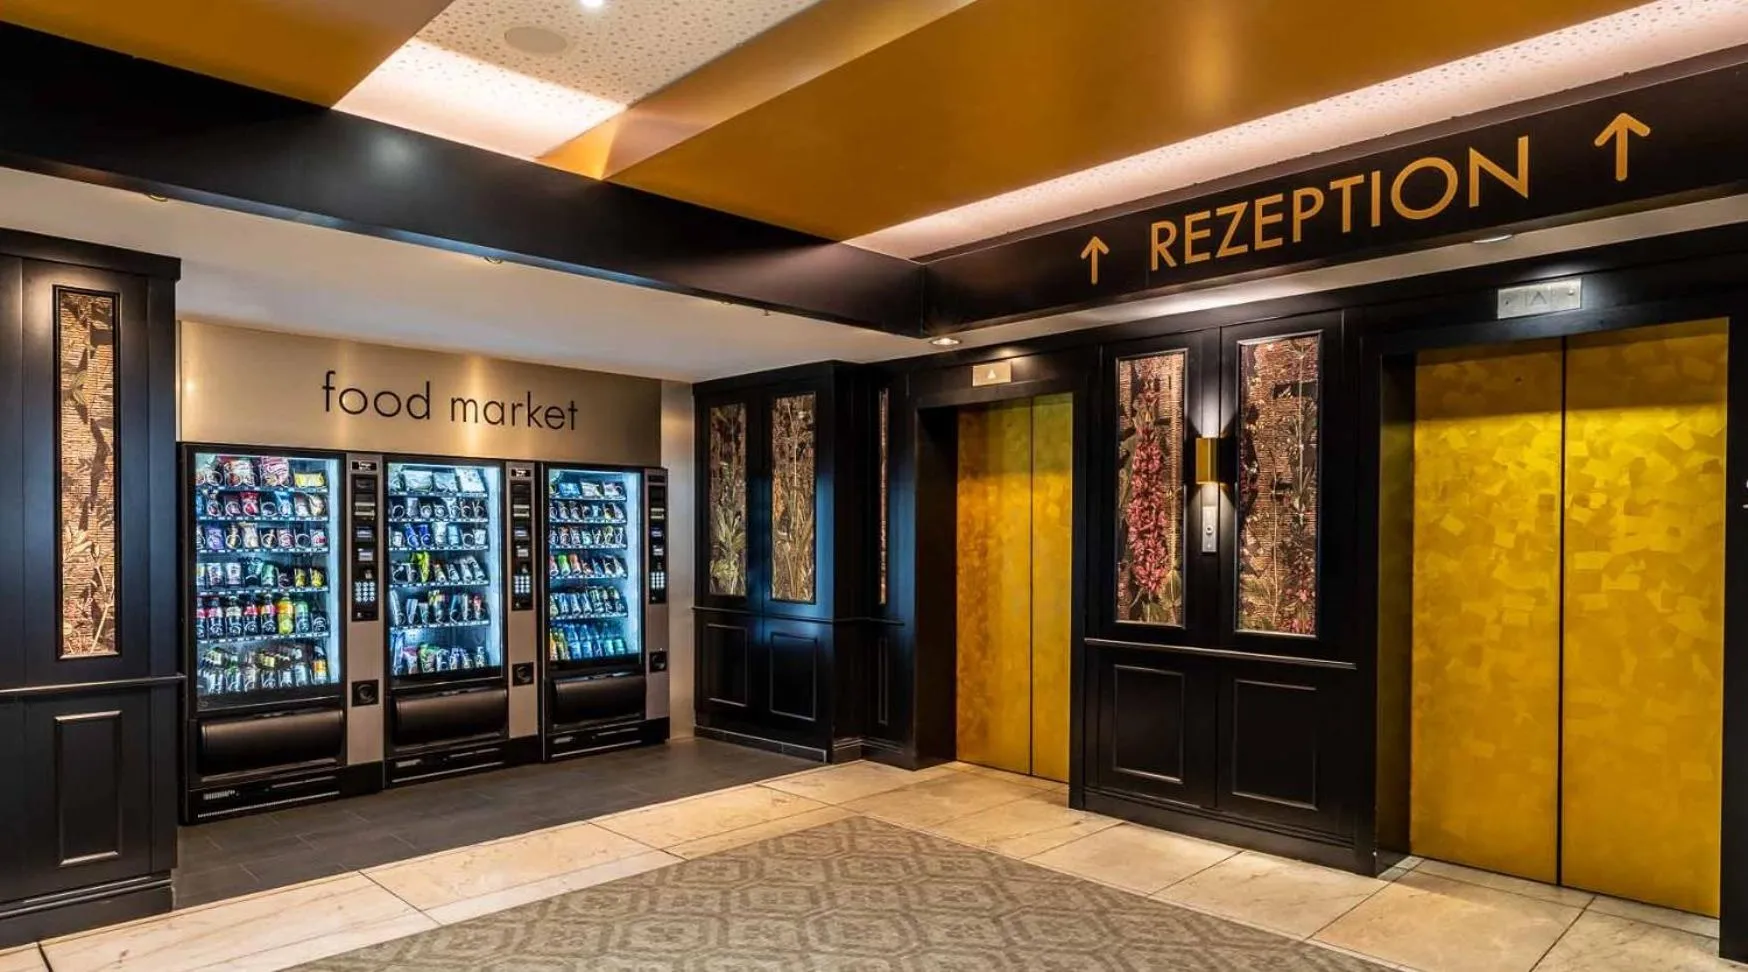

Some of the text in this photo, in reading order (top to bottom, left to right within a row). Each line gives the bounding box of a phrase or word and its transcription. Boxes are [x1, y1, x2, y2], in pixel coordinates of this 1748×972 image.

[1151, 136, 1529, 271] REZEPTION
[322, 371, 578, 430] food market
